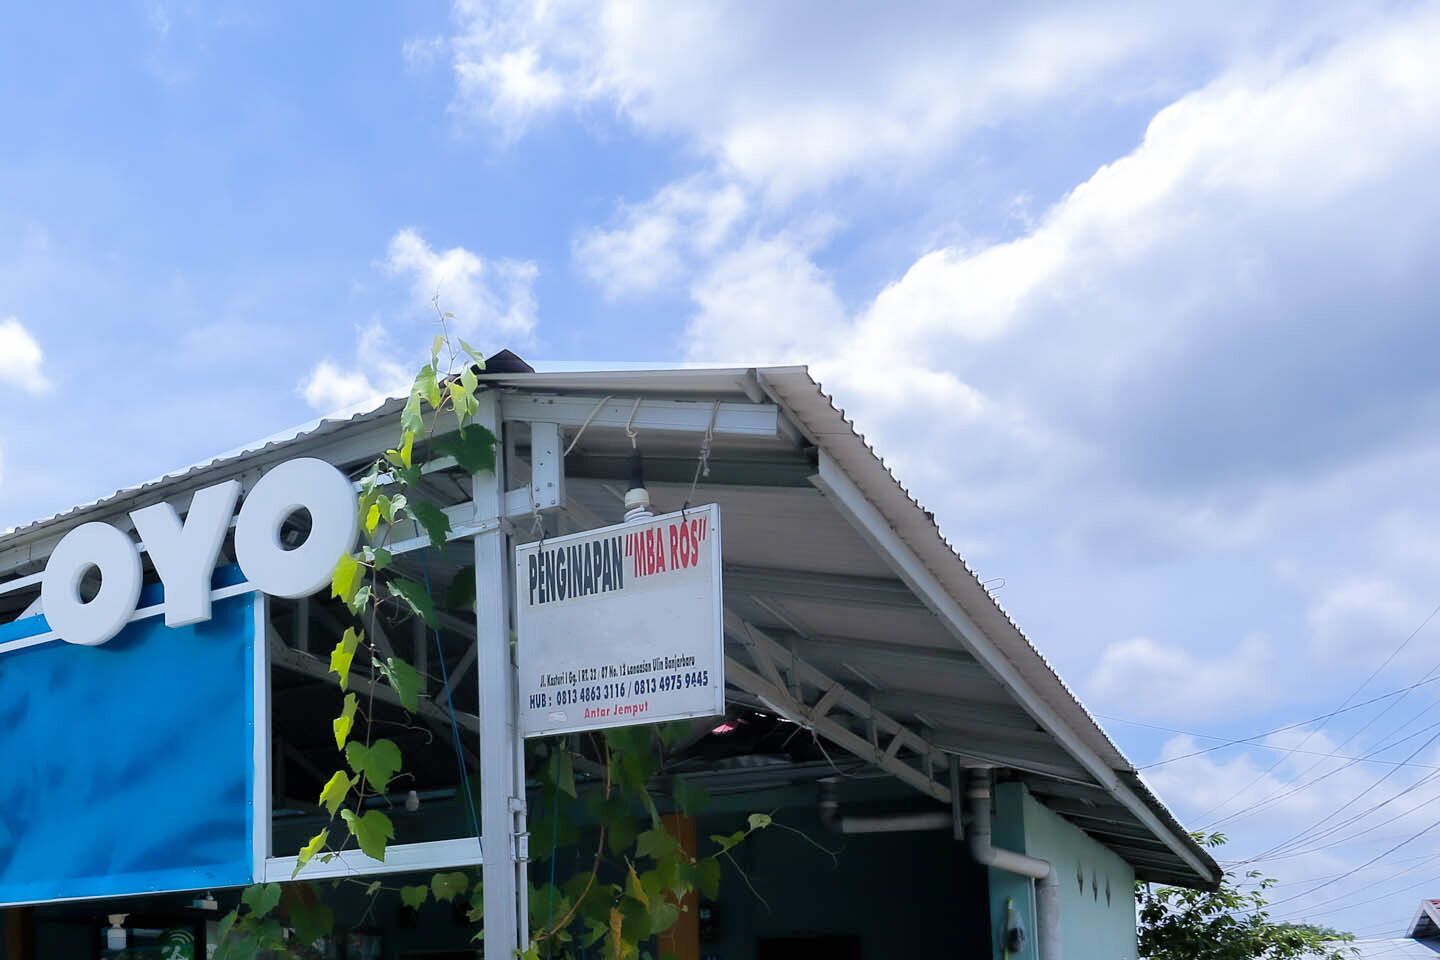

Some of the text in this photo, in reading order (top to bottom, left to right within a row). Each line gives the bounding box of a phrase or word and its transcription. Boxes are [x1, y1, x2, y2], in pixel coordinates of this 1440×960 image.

[41, 457, 360, 646] OYO
[529, 536, 624, 606] PENGINAPAN
[556, 689, 578, 706] 0813
[579, 686, 601, 702] 4863
[603, 682, 625, 700] 3116
[634, 678, 657, 696] 0813
[659, 674, 682, 692] 4975
[584, 701, 648, 719] Antar Jemput
